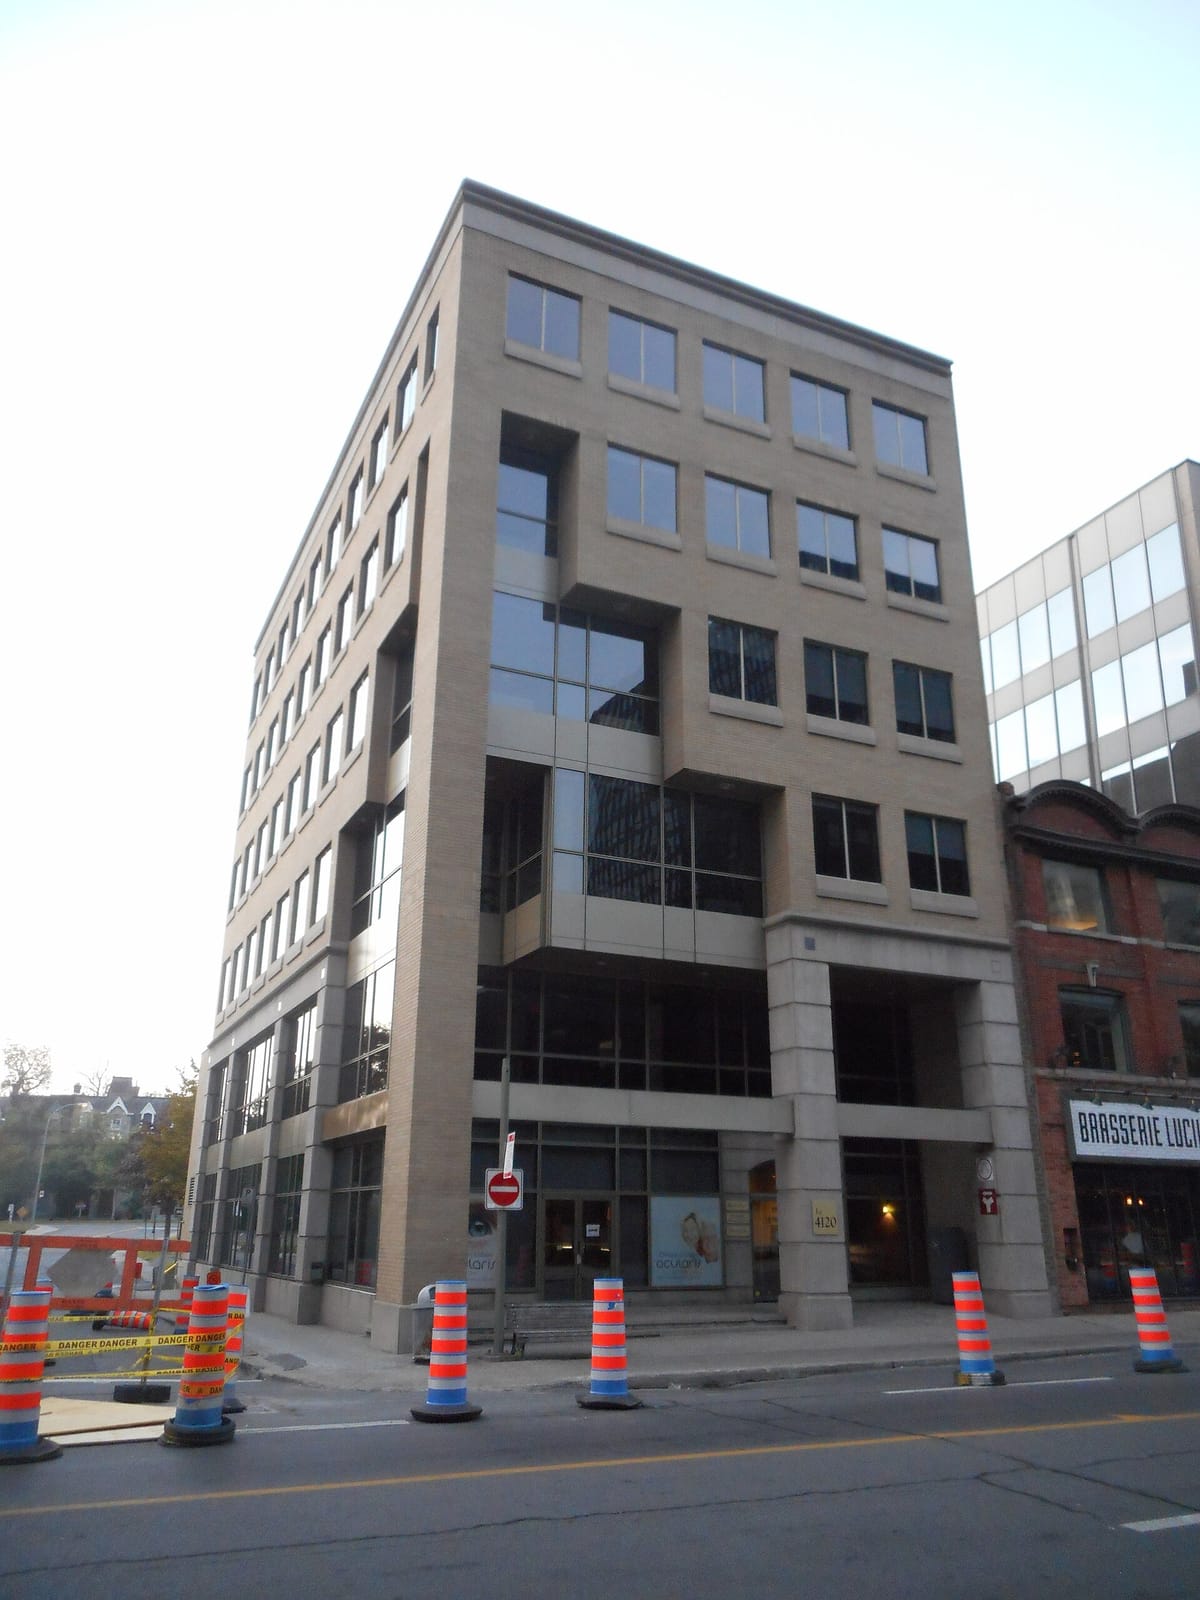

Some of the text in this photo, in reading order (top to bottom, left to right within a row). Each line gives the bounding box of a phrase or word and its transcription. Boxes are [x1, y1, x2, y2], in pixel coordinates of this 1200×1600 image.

[1078, 1112, 1163, 1145] BRASSERIE
[815, 1216, 837, 1228] 4120
[58, 1341, 97, 1349] DANGER
[99, 1338, 138, 1347] DANGER
[158, 1336, 194, 1344] DANGER
